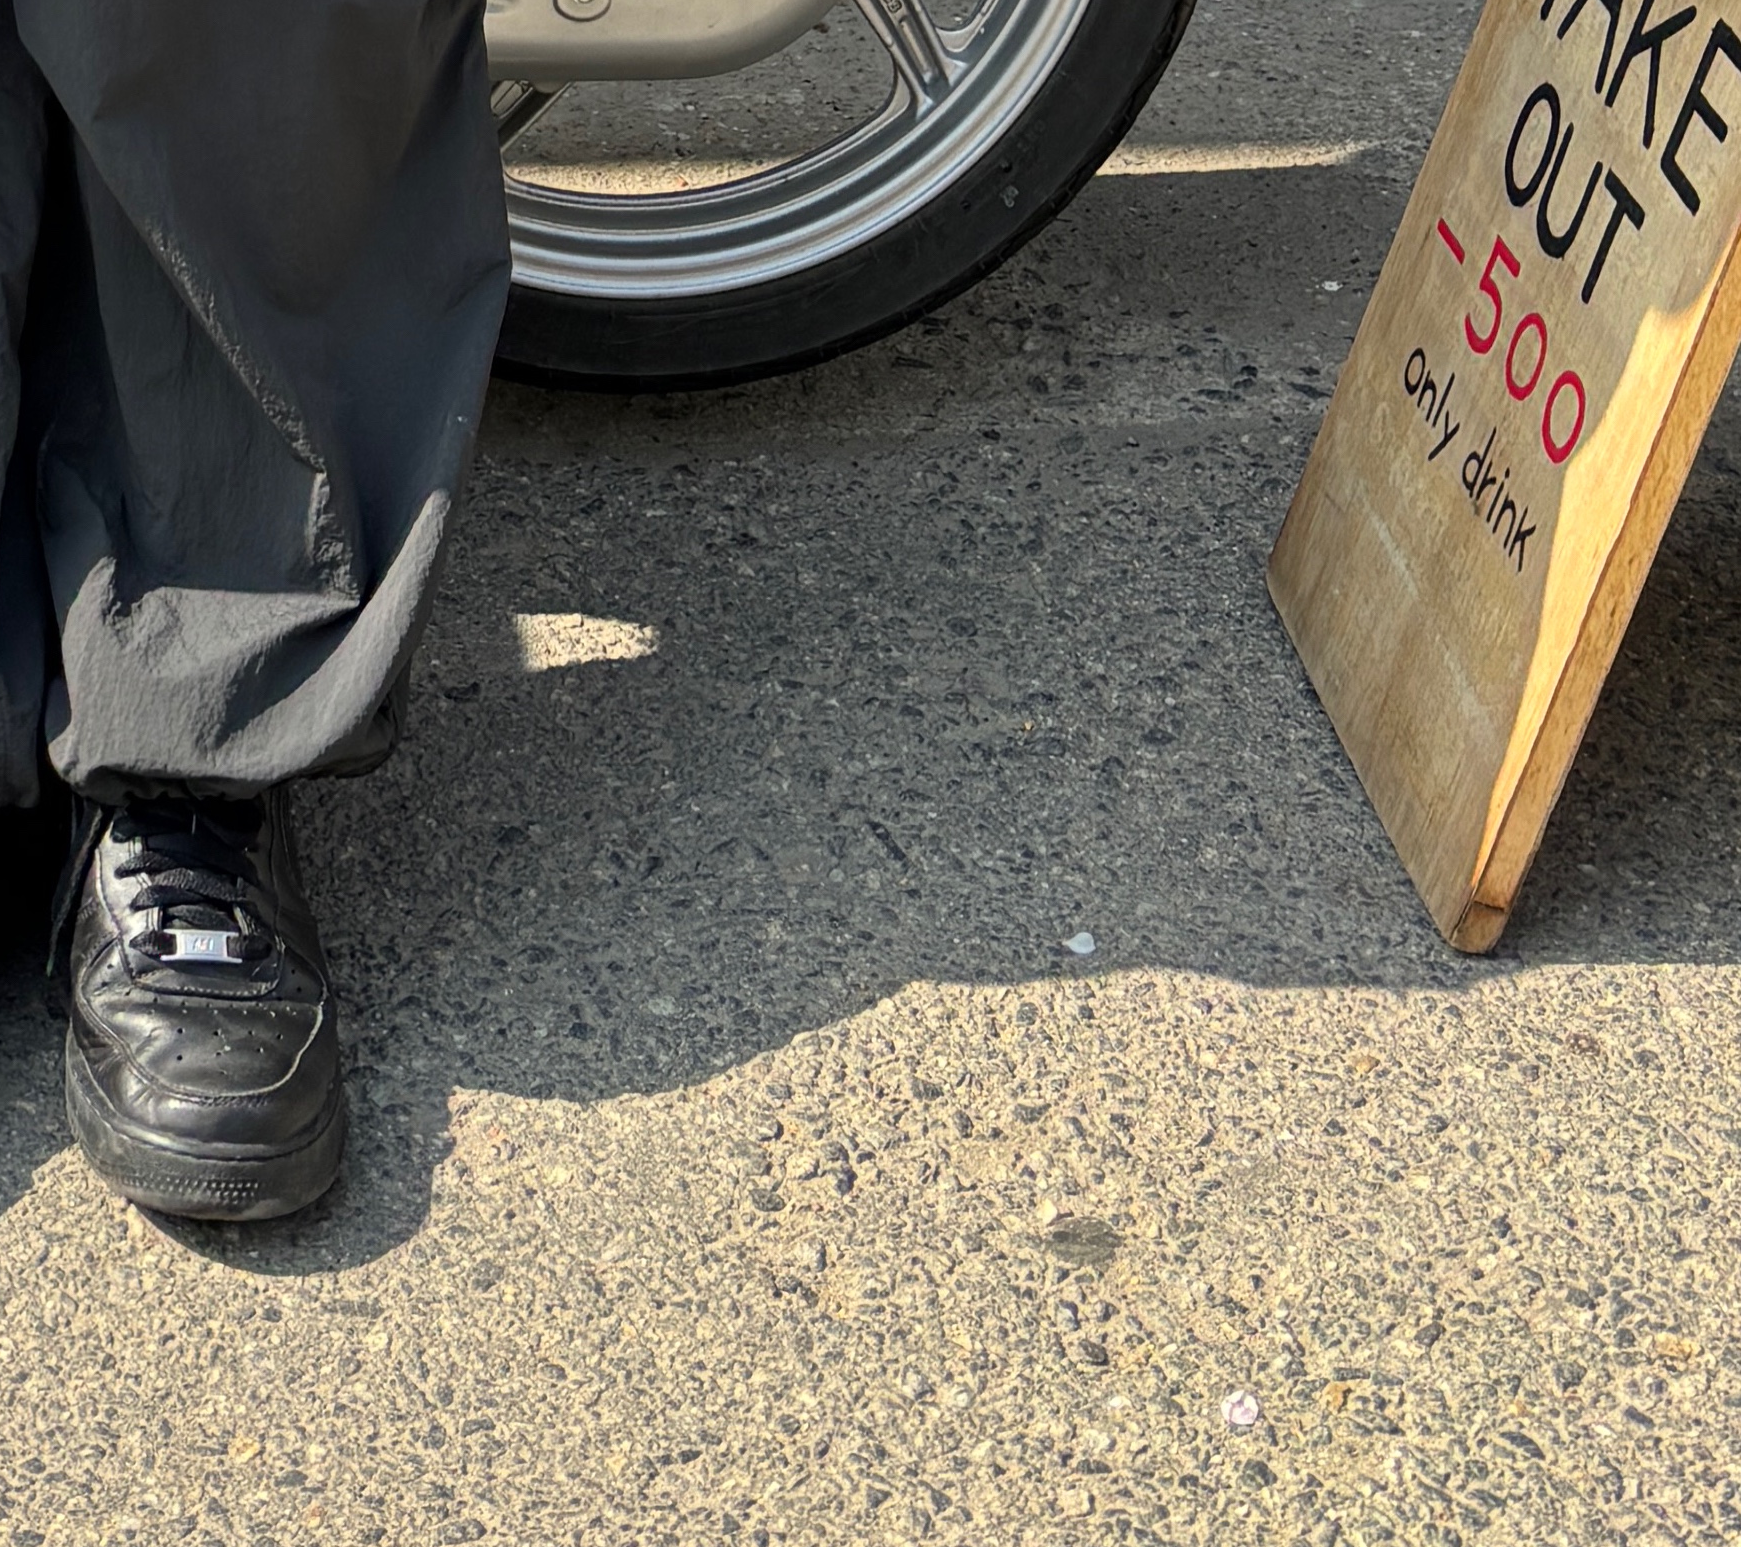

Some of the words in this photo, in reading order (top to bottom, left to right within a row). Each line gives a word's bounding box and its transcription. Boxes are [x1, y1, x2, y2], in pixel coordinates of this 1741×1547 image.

[1504, 81, 1646, 305] OUT
[1404, 346, 1461, 461] only
[1461, 426, 1537, 573] drink
